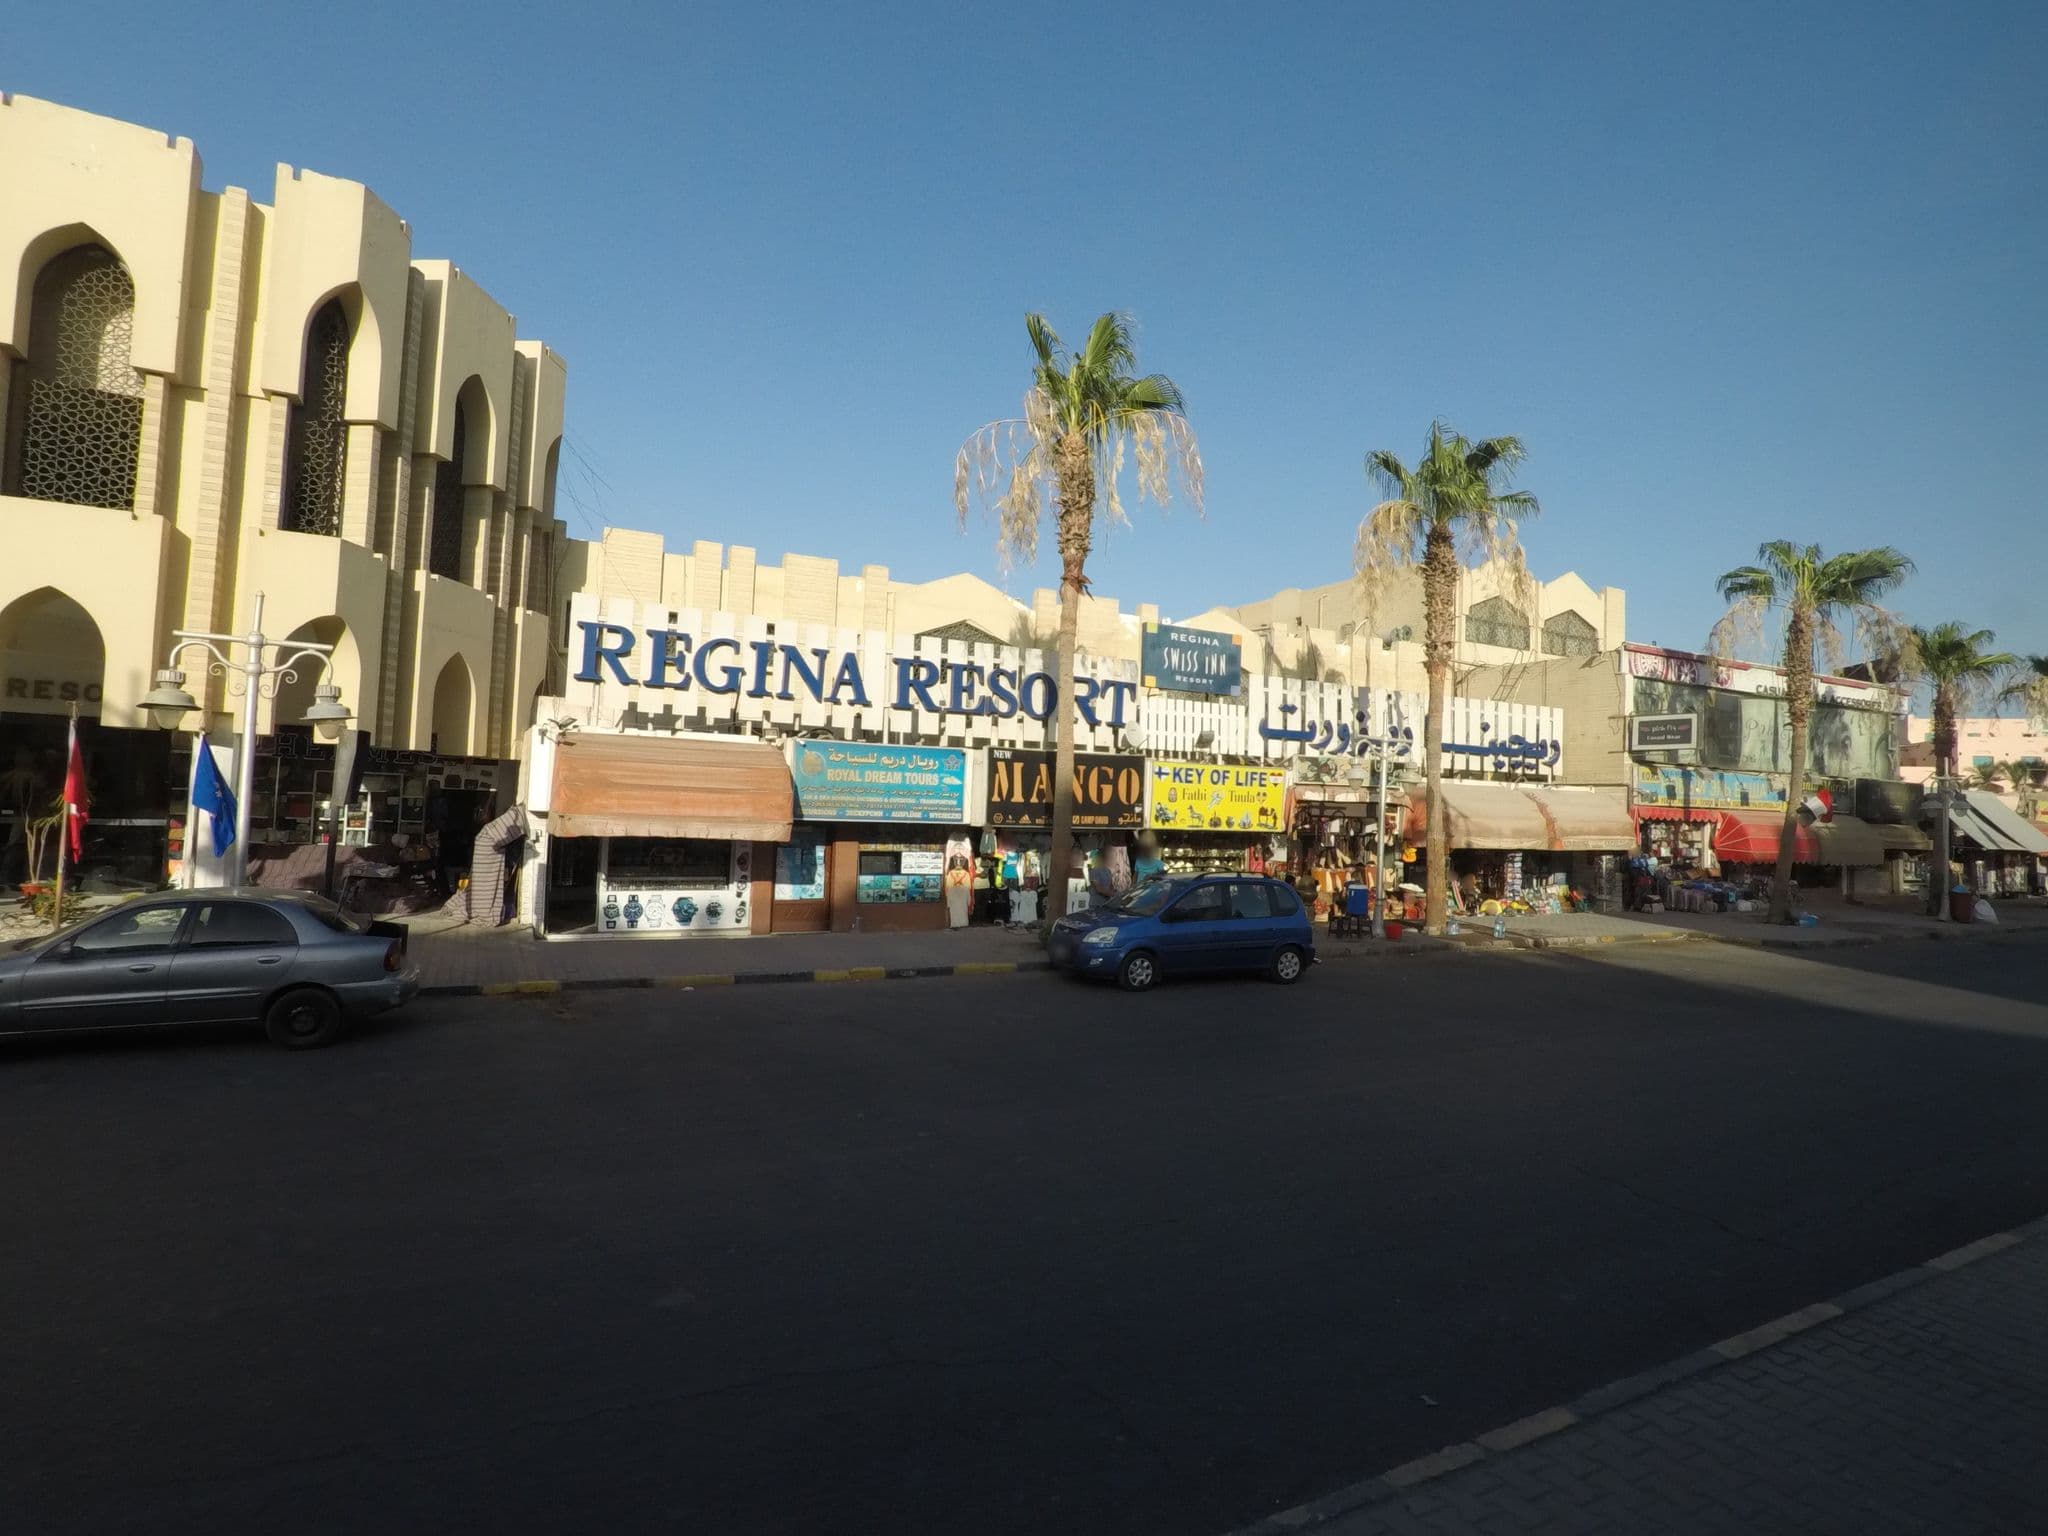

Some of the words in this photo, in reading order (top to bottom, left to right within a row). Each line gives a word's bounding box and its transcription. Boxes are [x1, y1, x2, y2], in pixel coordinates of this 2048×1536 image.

[1170, 632, 1219, 647] REGINA
[574, 619, 871, 707] REGINA
[892, 656, 1137, 729] RESORT
[1175, 675, 1214, 685] RESORT
[993, 750, 1012, 759] NEW
[827, 769, 862, 782] ROYAL
[864, 771, 902, 785] DREAM
[904, 773, 939, 786] TOURS
[991, 761, 1140, 805] MANGO
[1172, 767, 1205, 784] KEY
[1210, 769, 1231, 785] OF
[1235, 771, 1267, 787] LIFE
[1182, 788, 1207, 801] Fathi
